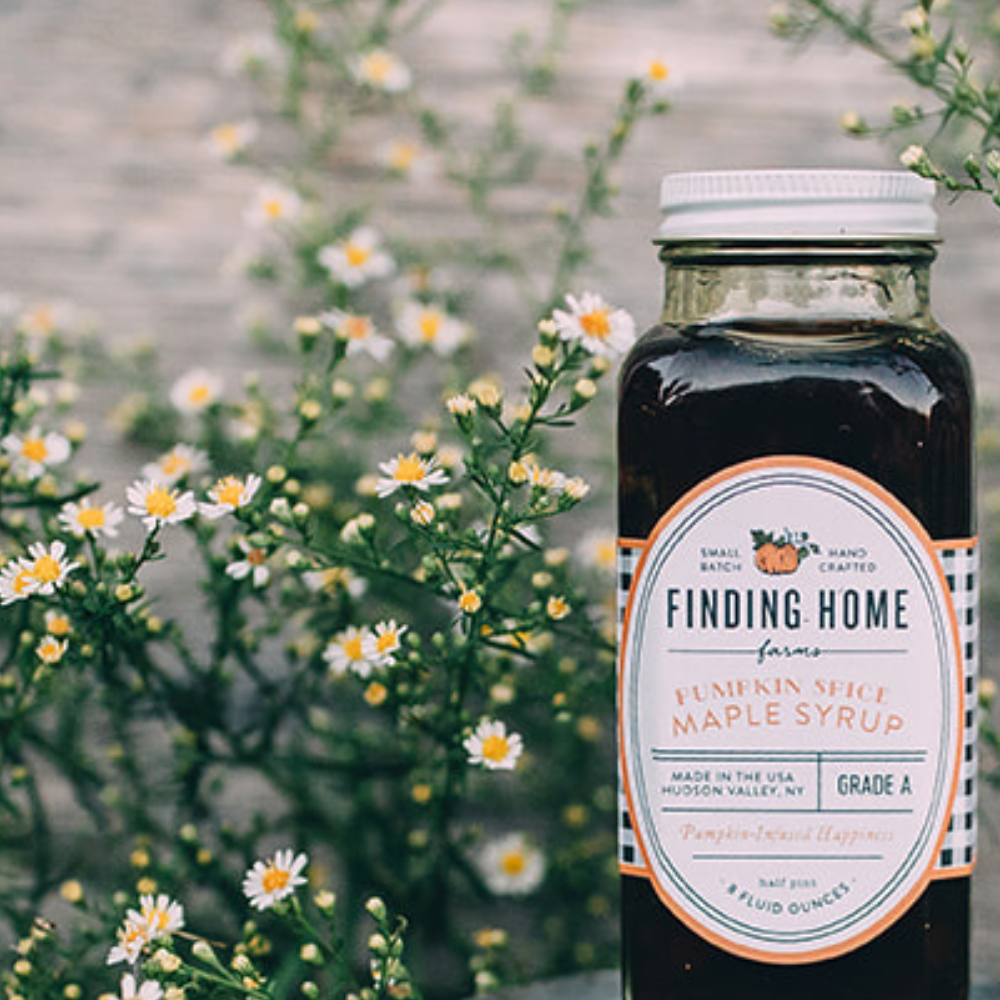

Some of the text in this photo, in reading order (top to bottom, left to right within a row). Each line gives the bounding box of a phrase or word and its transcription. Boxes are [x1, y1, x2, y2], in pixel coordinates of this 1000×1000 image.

[828, 548, 868, 558] HAND
[701, 562, 742, 573] BATCH
[819, 562, 877, 573] CRAFTED
[667, 589, 909, 629] FINDING HOME
[757, 639, 821, 665] farms
[675, 677, 891, 706] PUMPKIN SPICE
[672, 702, 904, 738] MAPLE SYRUP
[671, 771, 794, 783] MADE IN THE USA
[837, 773, 913, 796] GRADE A
[661, 784, 805, 798] HUDSON VALLEY, NY
[738, 890, 784, 915] FLUID
[787, 882, 851, 915] OUNCES
